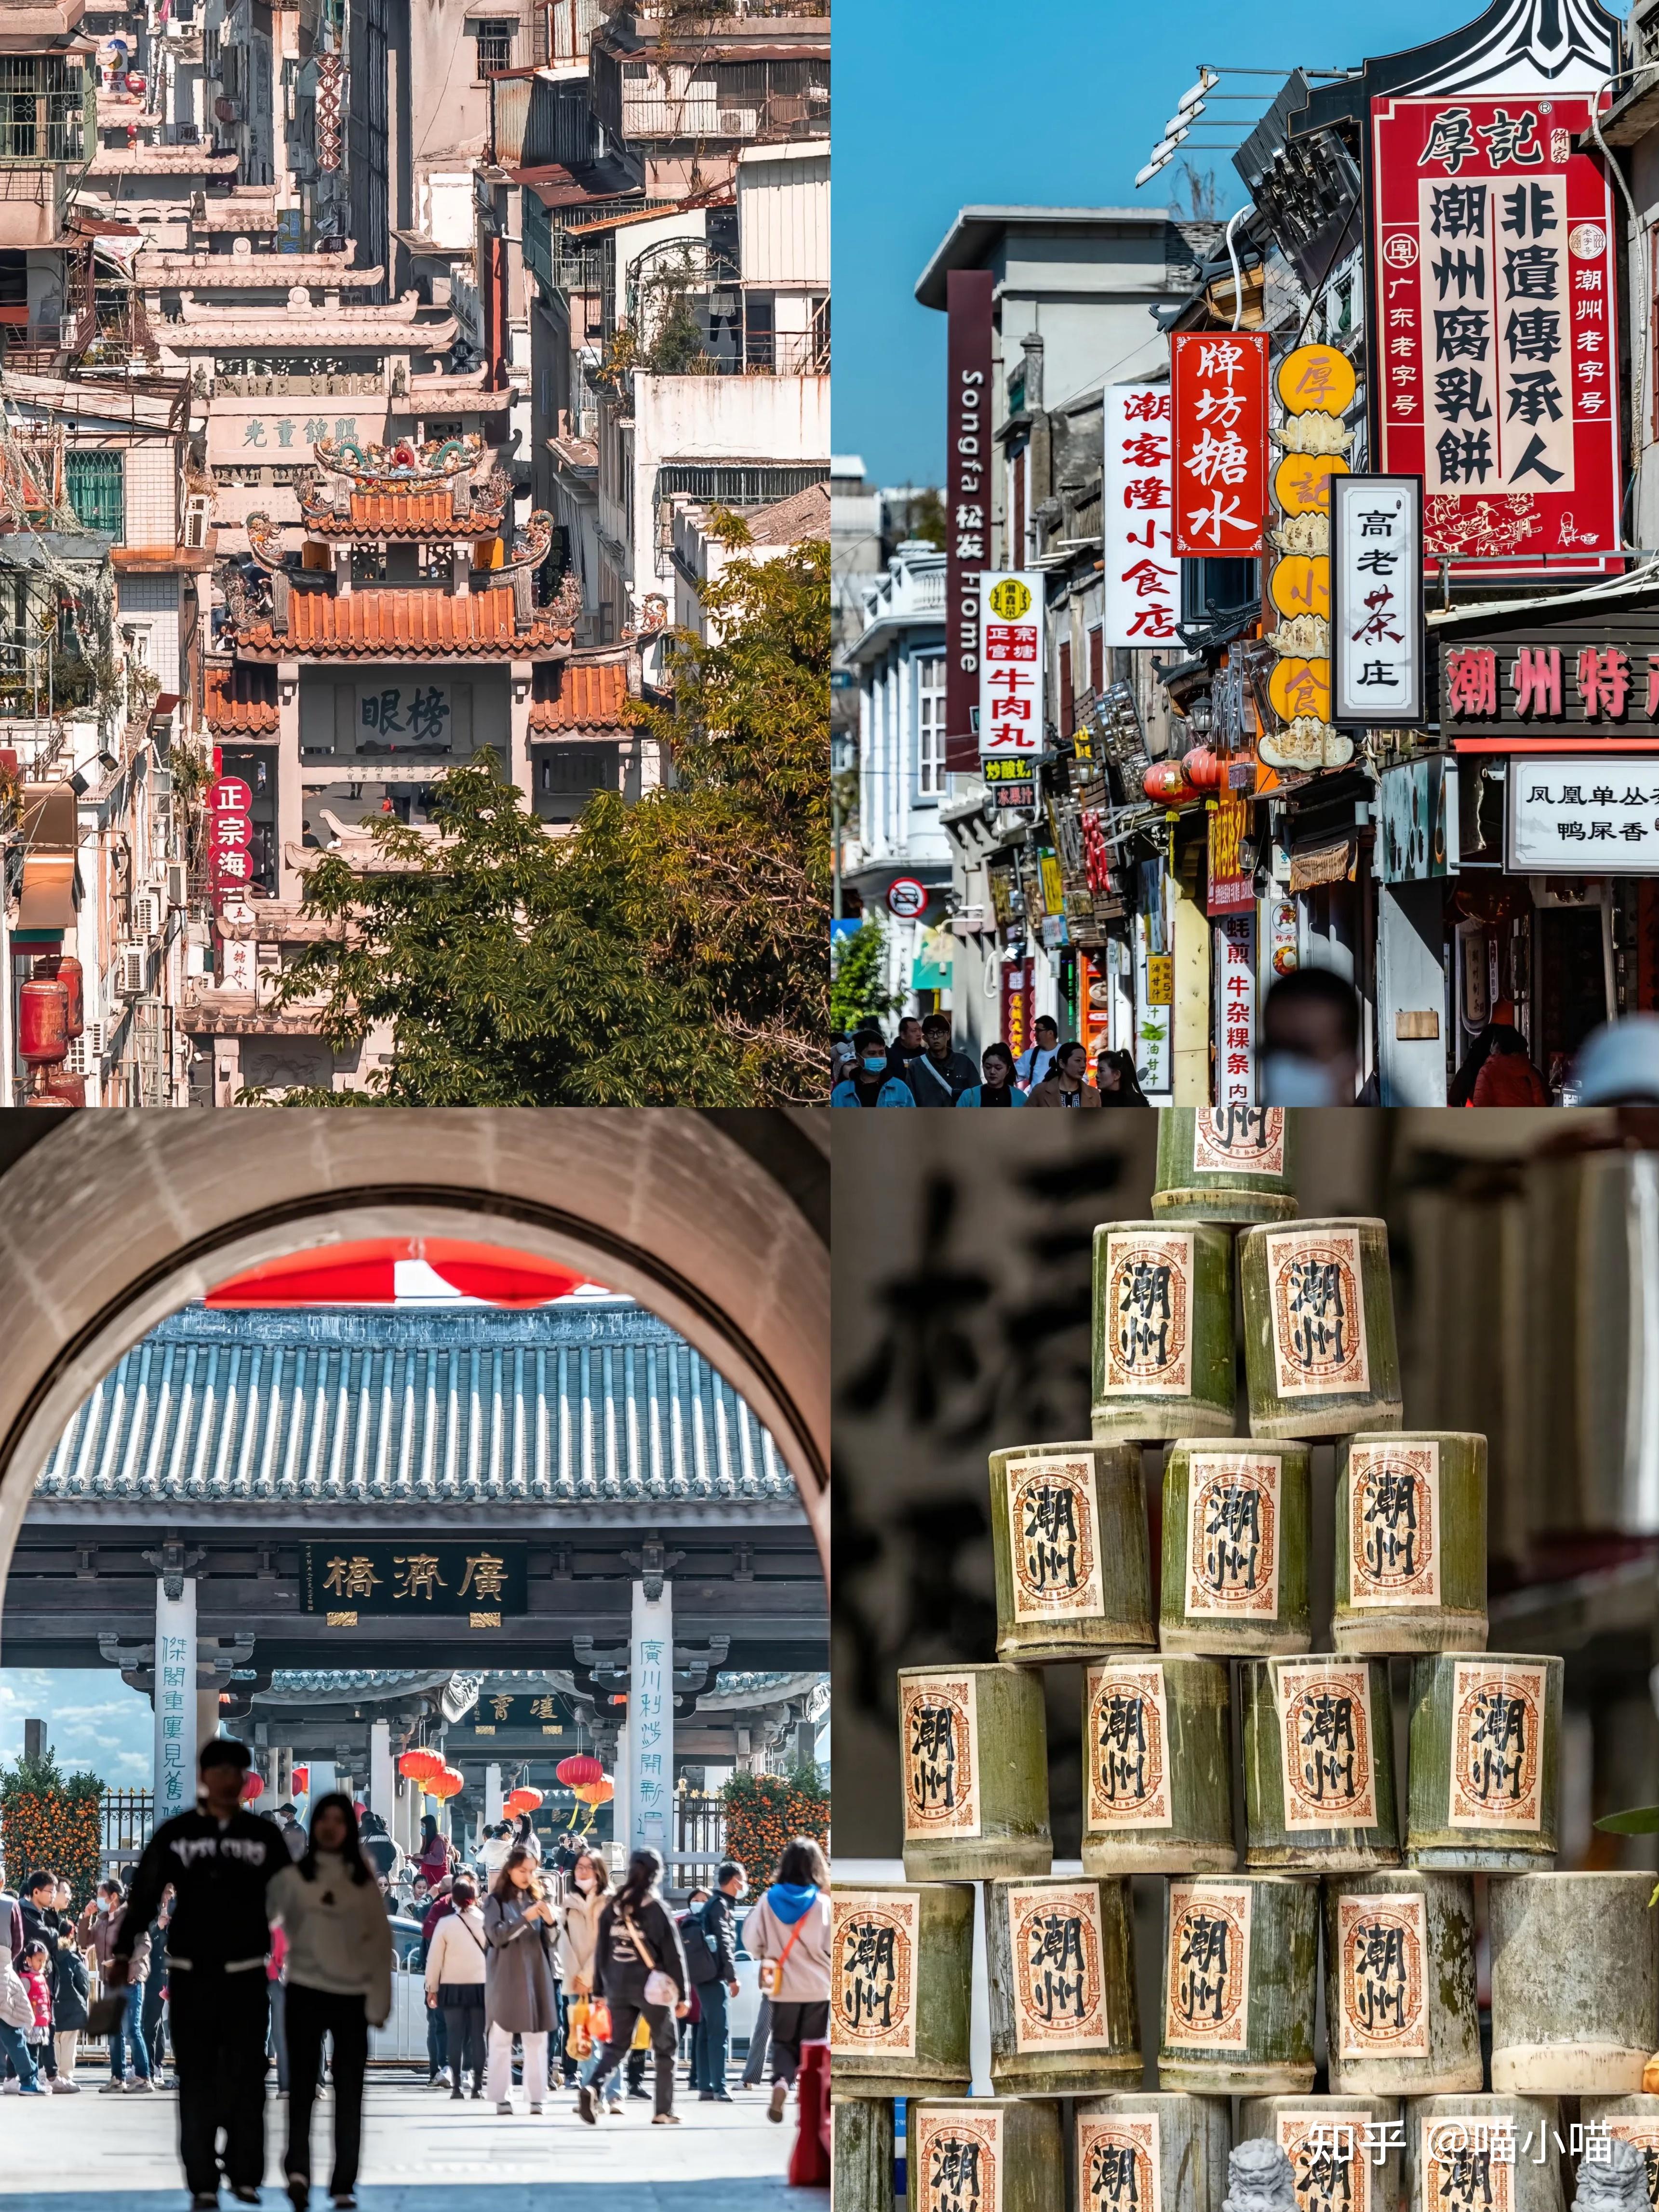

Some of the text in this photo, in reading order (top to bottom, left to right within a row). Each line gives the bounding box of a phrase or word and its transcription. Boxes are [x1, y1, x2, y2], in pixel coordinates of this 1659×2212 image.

[1417, 107, 1544, 173] 厚記
[1389, 278, 1418, 415] 广东老字号
[1430, 183, 1494, 485] 潮州腐乳餅
[1500, 182, 1565, 485] 非遺傳承人
[1575, 269, 1605, 413] 潮州老字号
[1183, 340, 1258, 546] 牌坊糖水
[955, 370, 985, 672] Songfa 松发 Home
[1122, 391, 1178, 638] 潮客隆小食店
[1285, 357, 1337, 714] 厚記小食
[988, 627, 1036, 642] 正宗
[988, 644, 1036, 659] 官塘
[1351, 510, 1405, 686] 高老茶庄
[988, 668, 1035, 747] 牛肉丸
[1445, 646, 1659, 718] 潮州特
[997, 786, 1033, 806] 水果汁
[1557, 821, 1649, 841] 鸭屎香
[1226, 917, 1250, 964] 蚝煎
[1275, 934, 1296, 943] 鸭母
[1147, 1043, 1159, 1086] 油甘汁
[1226, 976, 1250, 1075] 牛杂粿条
[1121, 1261, 1171, 1367] 潮州
[1290, 1259, 1345, 1367] 潮州
[322, 1551, 509, 1601] 廣濟橋
[1025, 1485, 1077, 1591] 潮州
[1206, 1485, 1260, 1591] 潮州
[1364, 1470, 1416, 1579] 潮州
[912, 1695, 955, 1811] 潮州
[1099, 1694, 1146, 1802] 潮州
[1302, 1692, 1355, 1801] 潮州
[1472, 1692, 1526, 1800] 潮州
[844, 1921, 896, 2029] 潮州
[1031, 1913, 1085, 2021] 潮州
[1180, 1914, 1228, 2021] 潮州
[1356, 1923, 1406, 2030] 潮州
